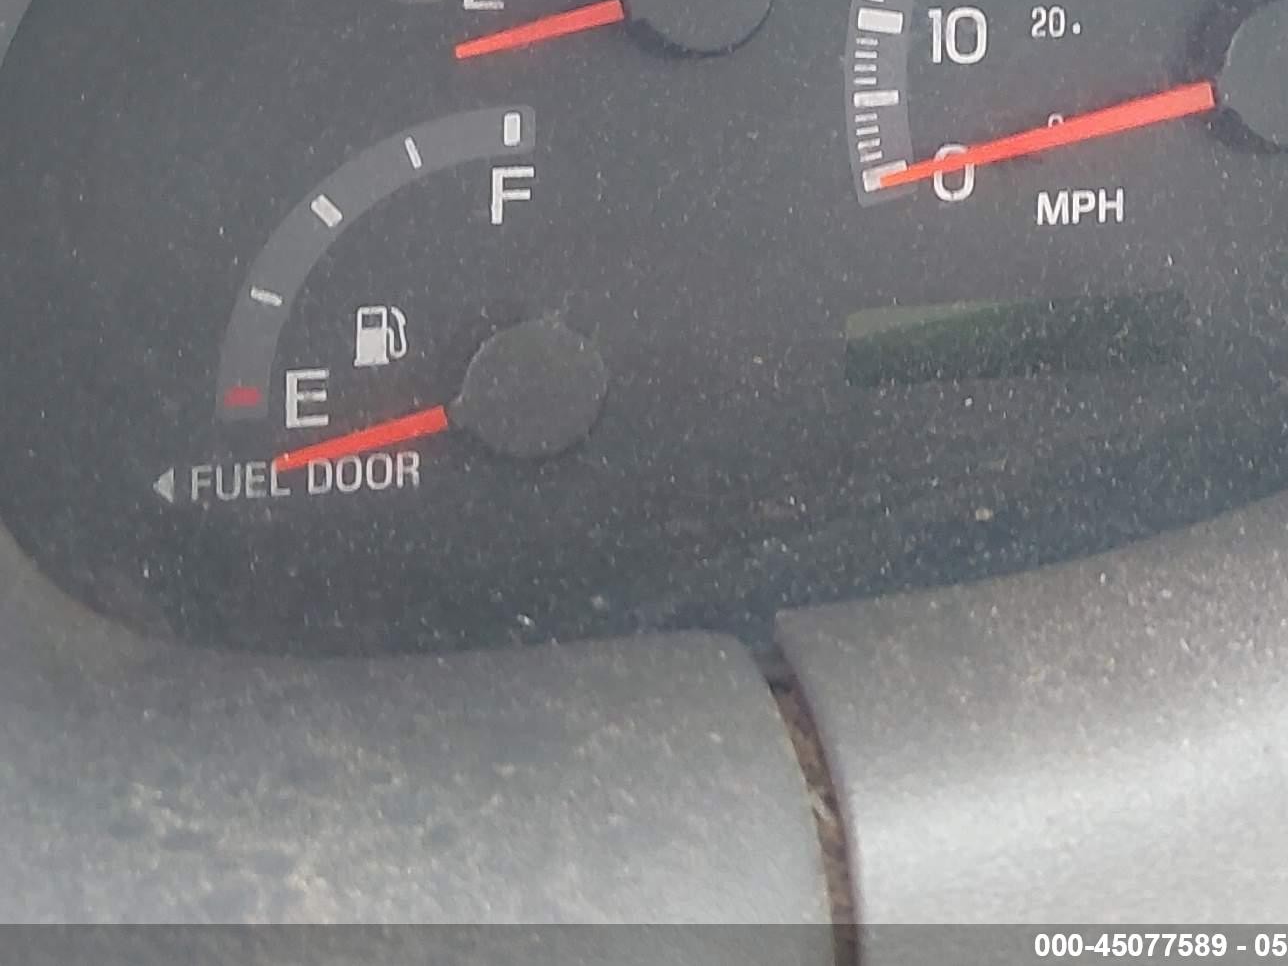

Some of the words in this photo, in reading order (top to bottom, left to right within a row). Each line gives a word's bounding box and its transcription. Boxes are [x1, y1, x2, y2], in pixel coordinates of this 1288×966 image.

[928, 7, 987, 64] 10
[1031, 6, 1066, 38] 20
[491, 166, 534, 224] F
[932, 143, 976, 202] 0
[1036, 188, 1125, 225] MPH
[285, 369, 329, 428] E
[190, 462, 291, 503] FUEL
[308, 451, 420, 496] DOOR
